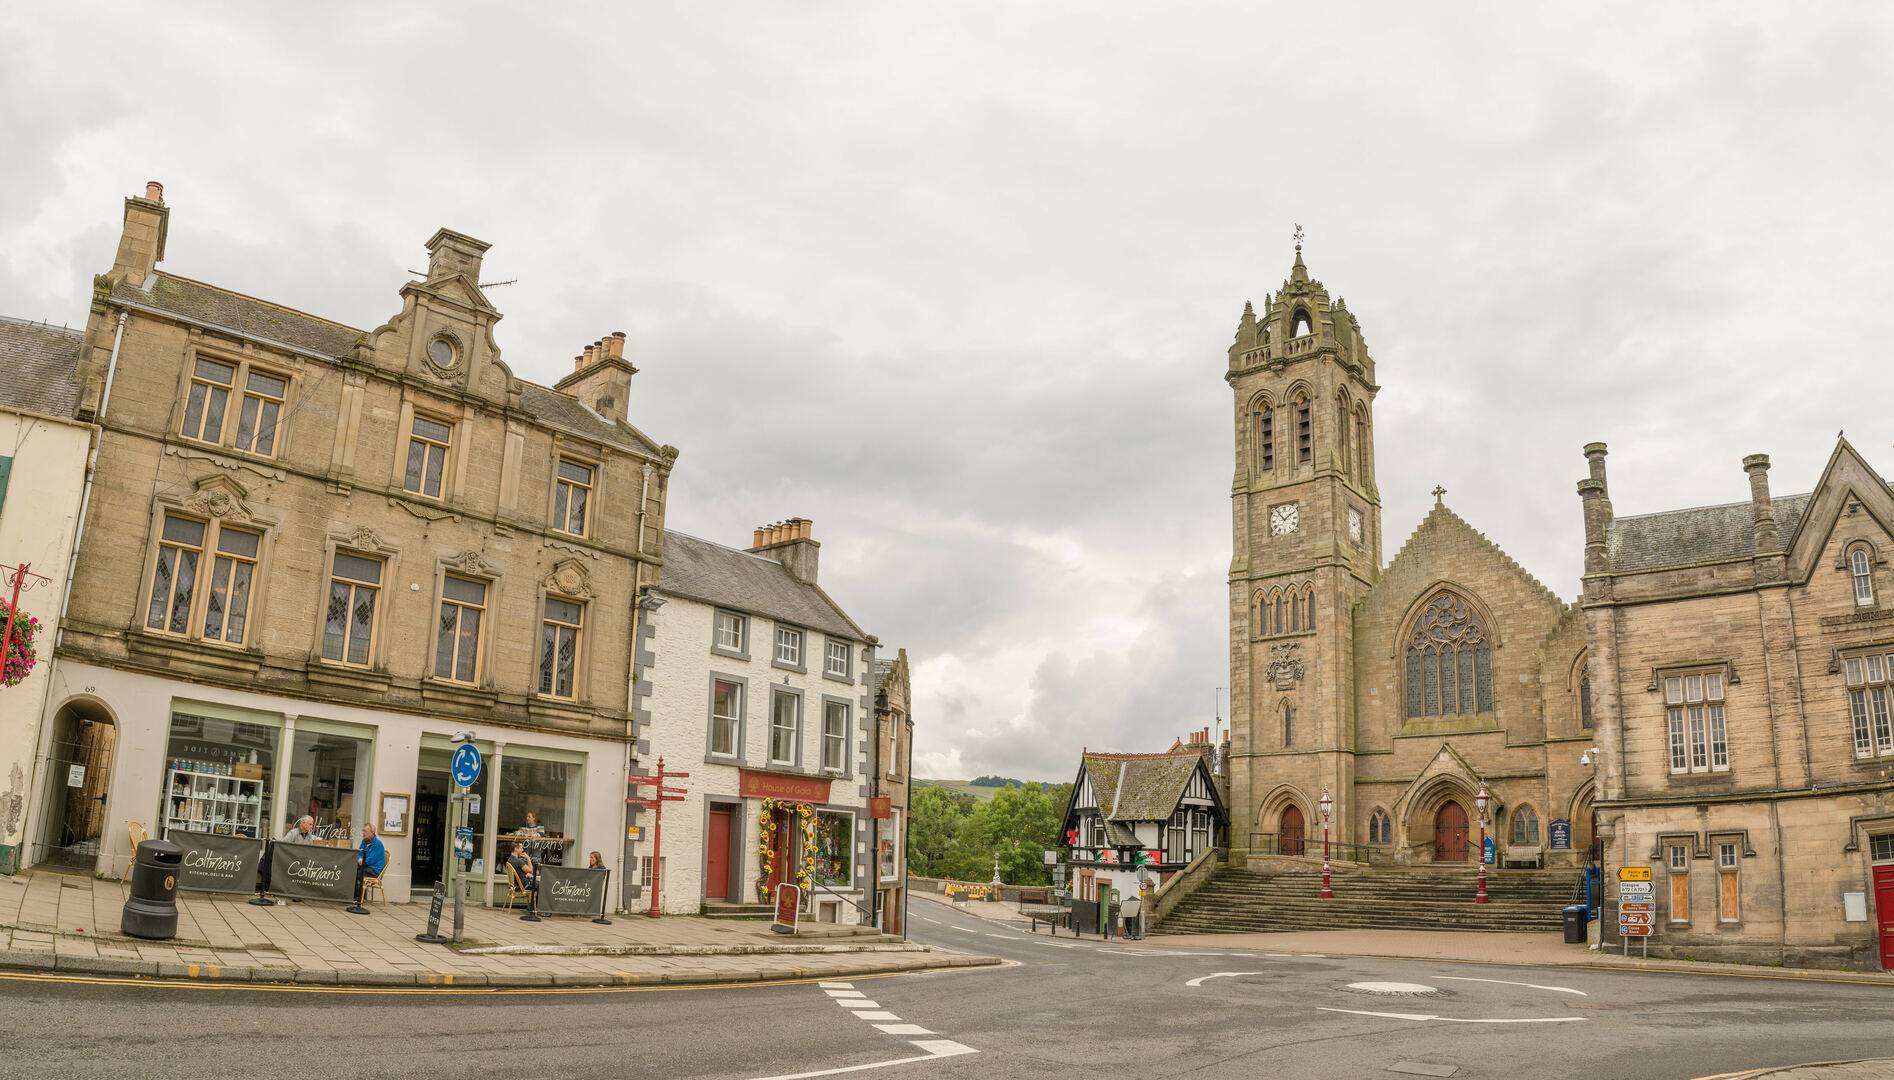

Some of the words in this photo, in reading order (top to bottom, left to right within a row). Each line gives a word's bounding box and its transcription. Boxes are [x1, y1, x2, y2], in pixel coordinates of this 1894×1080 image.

[762, 782, 785, 793] House
[785, 784, 794, 794] of
[184, 849, 243, 872] Coltman's
[287, 860, 342, 881] Coltman's
[552, 880, 591, 897] Coltman's
